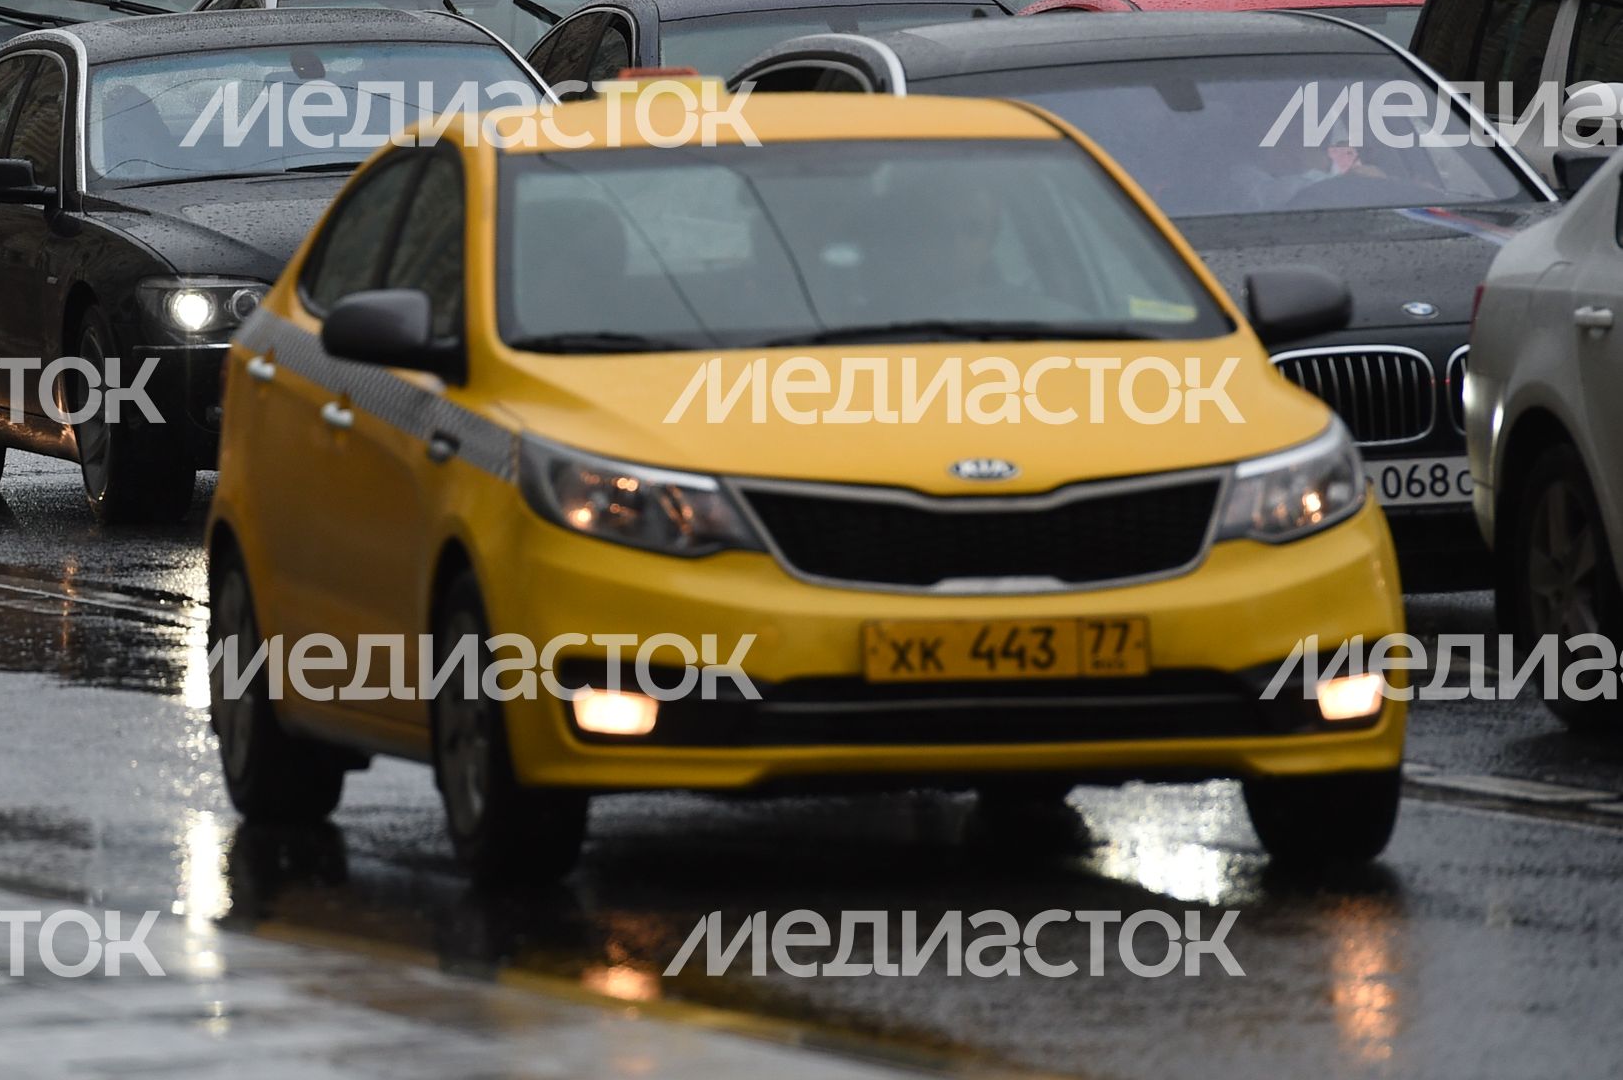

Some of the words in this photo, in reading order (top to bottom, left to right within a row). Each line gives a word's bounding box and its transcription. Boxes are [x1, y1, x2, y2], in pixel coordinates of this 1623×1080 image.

[889, 638, 944, 673] ХК
[969, 626, 1056, 670] 443
[1087, 623, 1130, 655] 77
